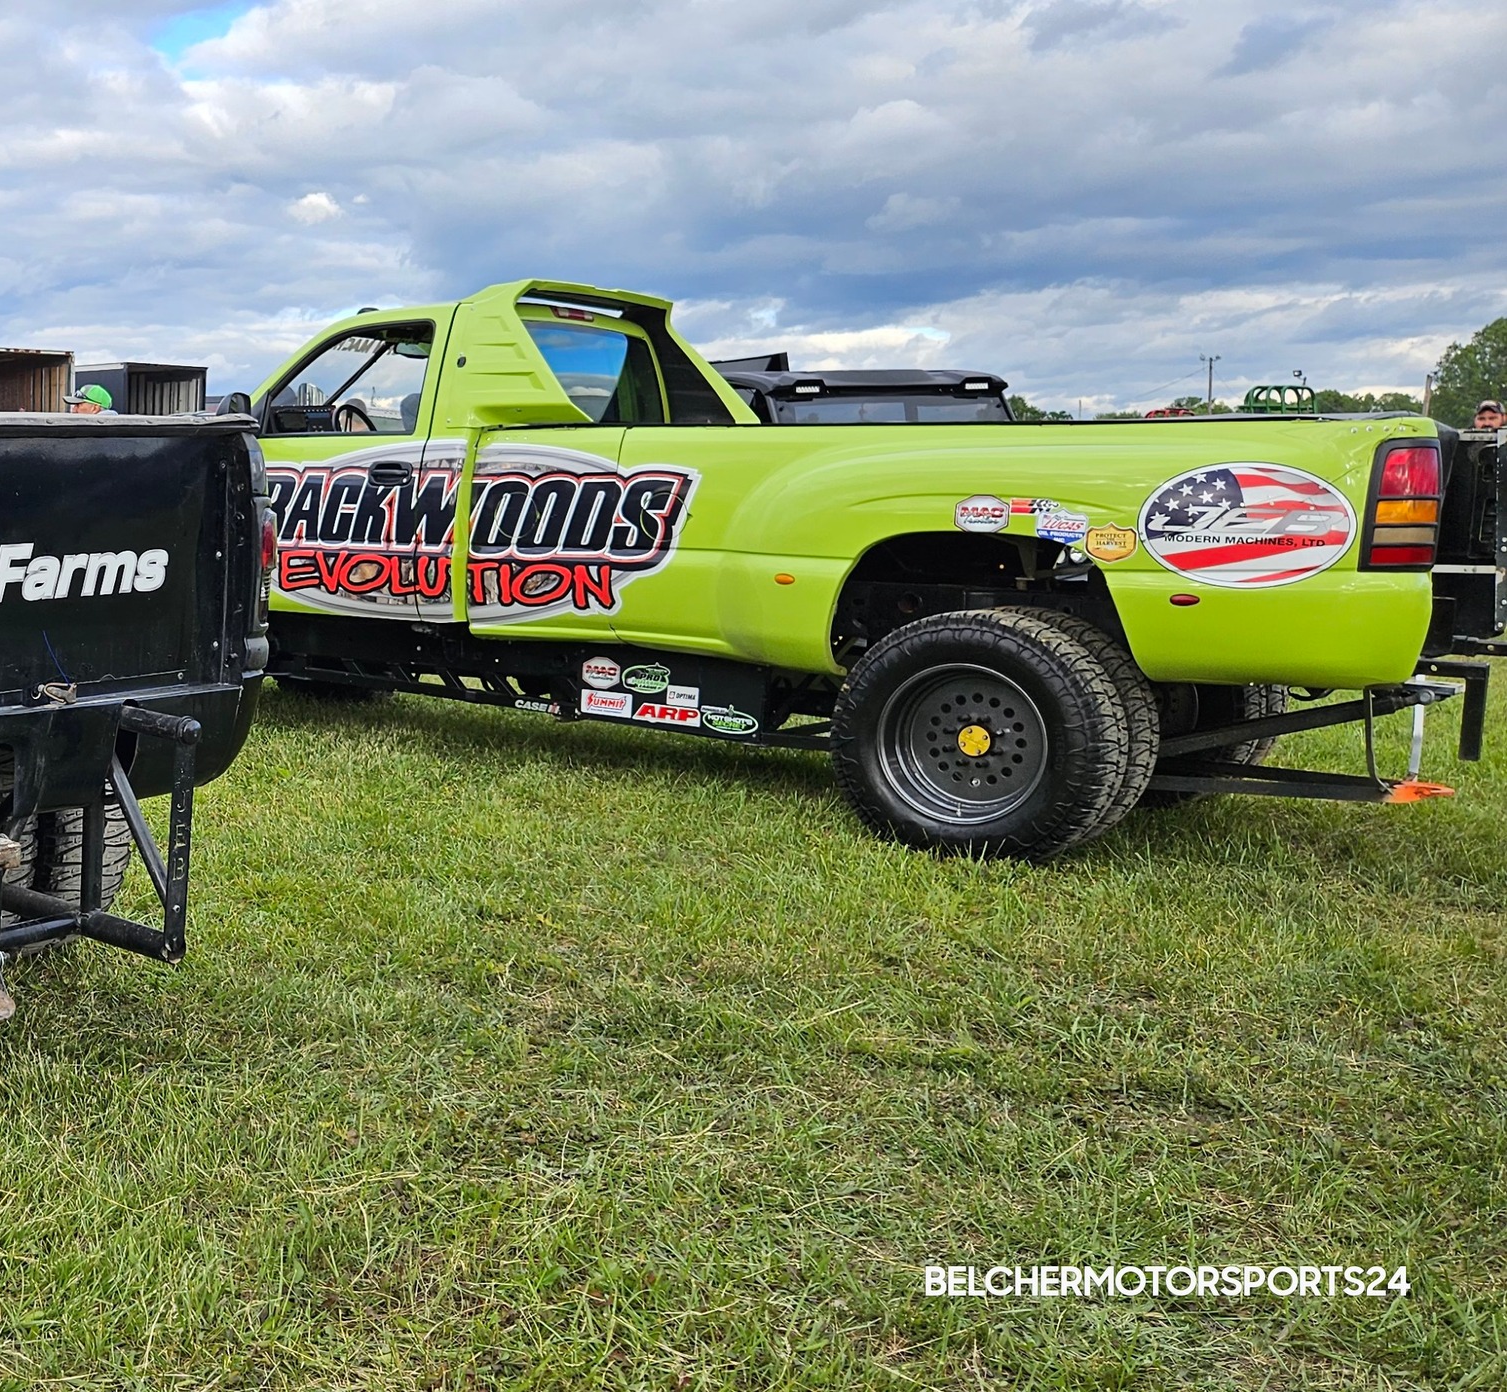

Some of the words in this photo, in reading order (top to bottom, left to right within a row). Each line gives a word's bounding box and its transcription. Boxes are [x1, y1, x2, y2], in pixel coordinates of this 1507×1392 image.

[960, 506, 1005, 518] MAC
[1042, 519, 1083, 531] LUCAS
[1147, 505, 1345, 536] JEB
[1164, 533, 1221, 544] MODERN
[1225, 535, 1298, 547] MACHINES,
[1301, 538, 1326, 547] LTD
[280, 550, 613, 608] EVOLUTION
[586, 692, 627, 710] SUMMIT
[675, 693, 696, 701] OPTIMA
[514, 699, 548, 712] CASE
[637, 704, 699, 722] ARP
